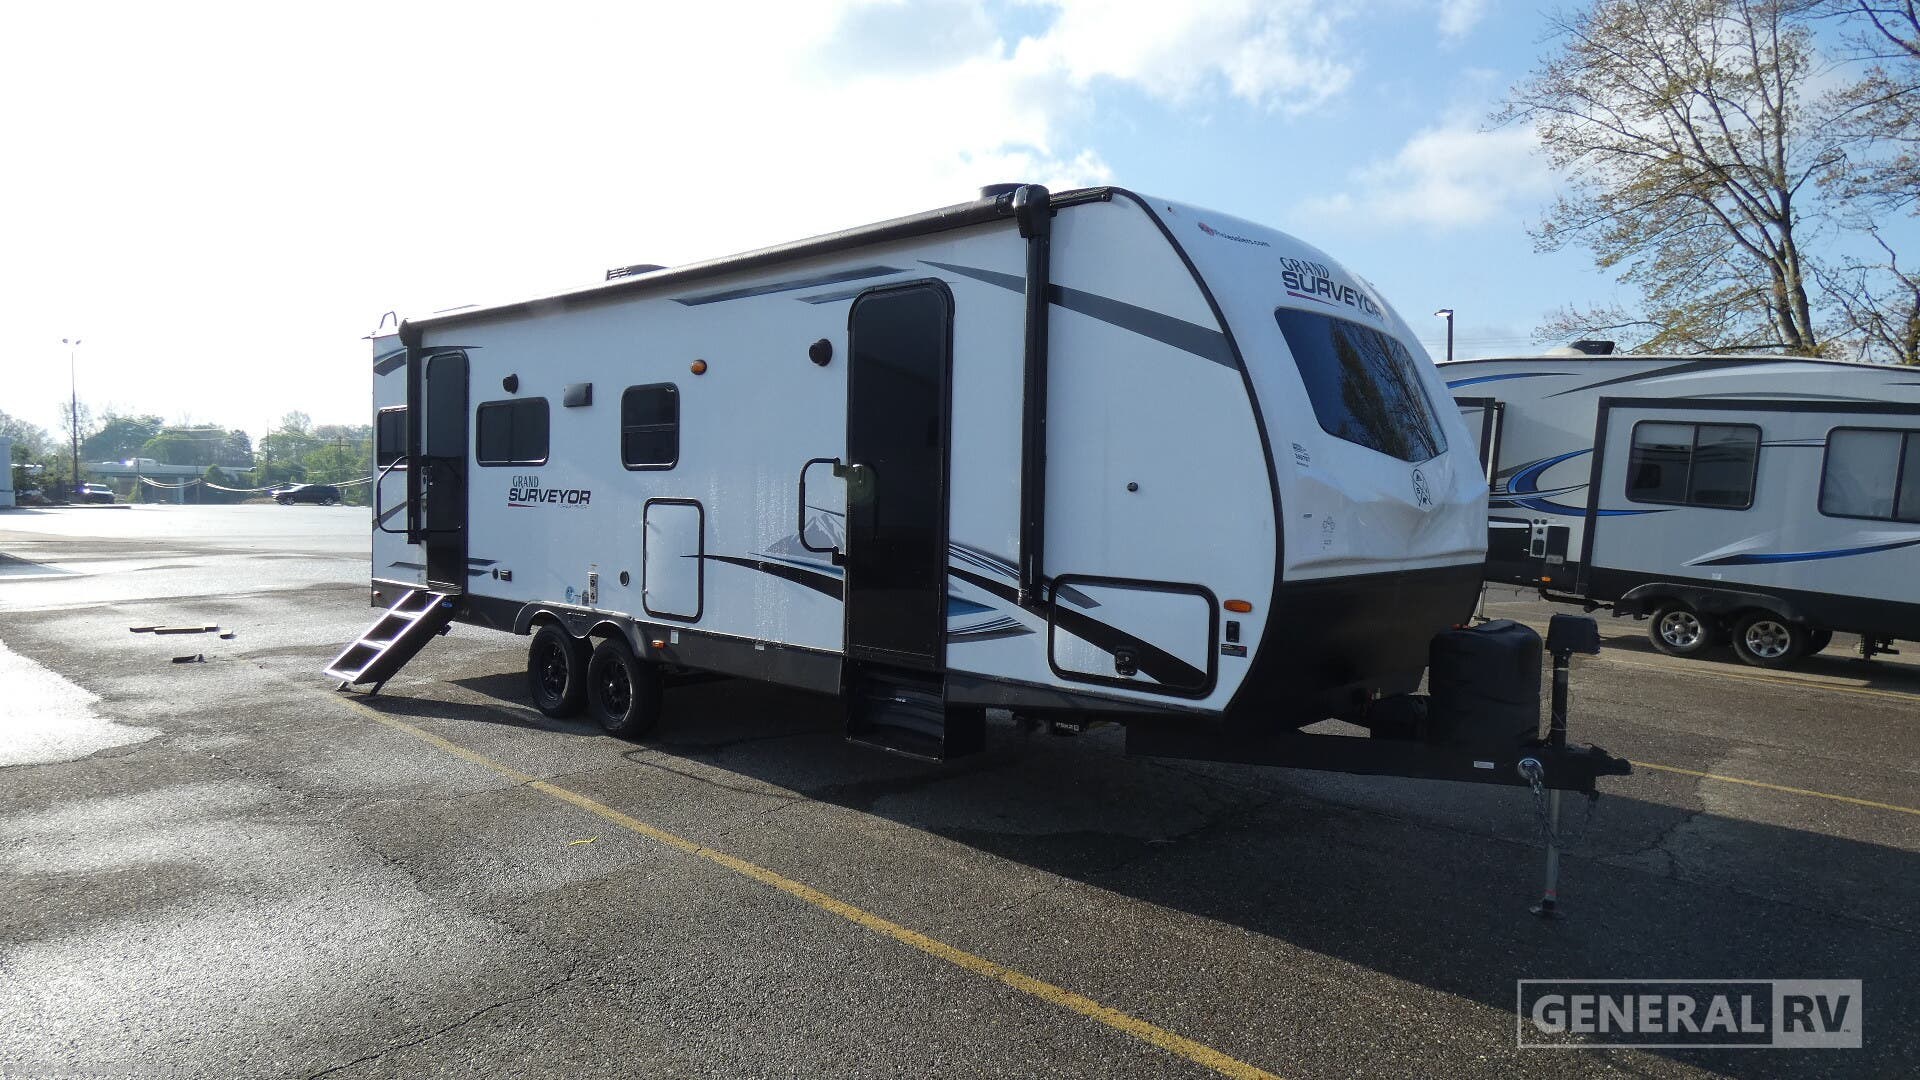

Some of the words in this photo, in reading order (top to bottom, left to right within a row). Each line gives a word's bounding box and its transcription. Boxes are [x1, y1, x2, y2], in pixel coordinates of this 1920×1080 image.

[1280, 256, 1330, 279] GRAND
[1281, 270, 1385, 322] SURVEYOR
[512, 475, 540, 489] GRAND
[508, 487, 592, 505] SURVEYOR
